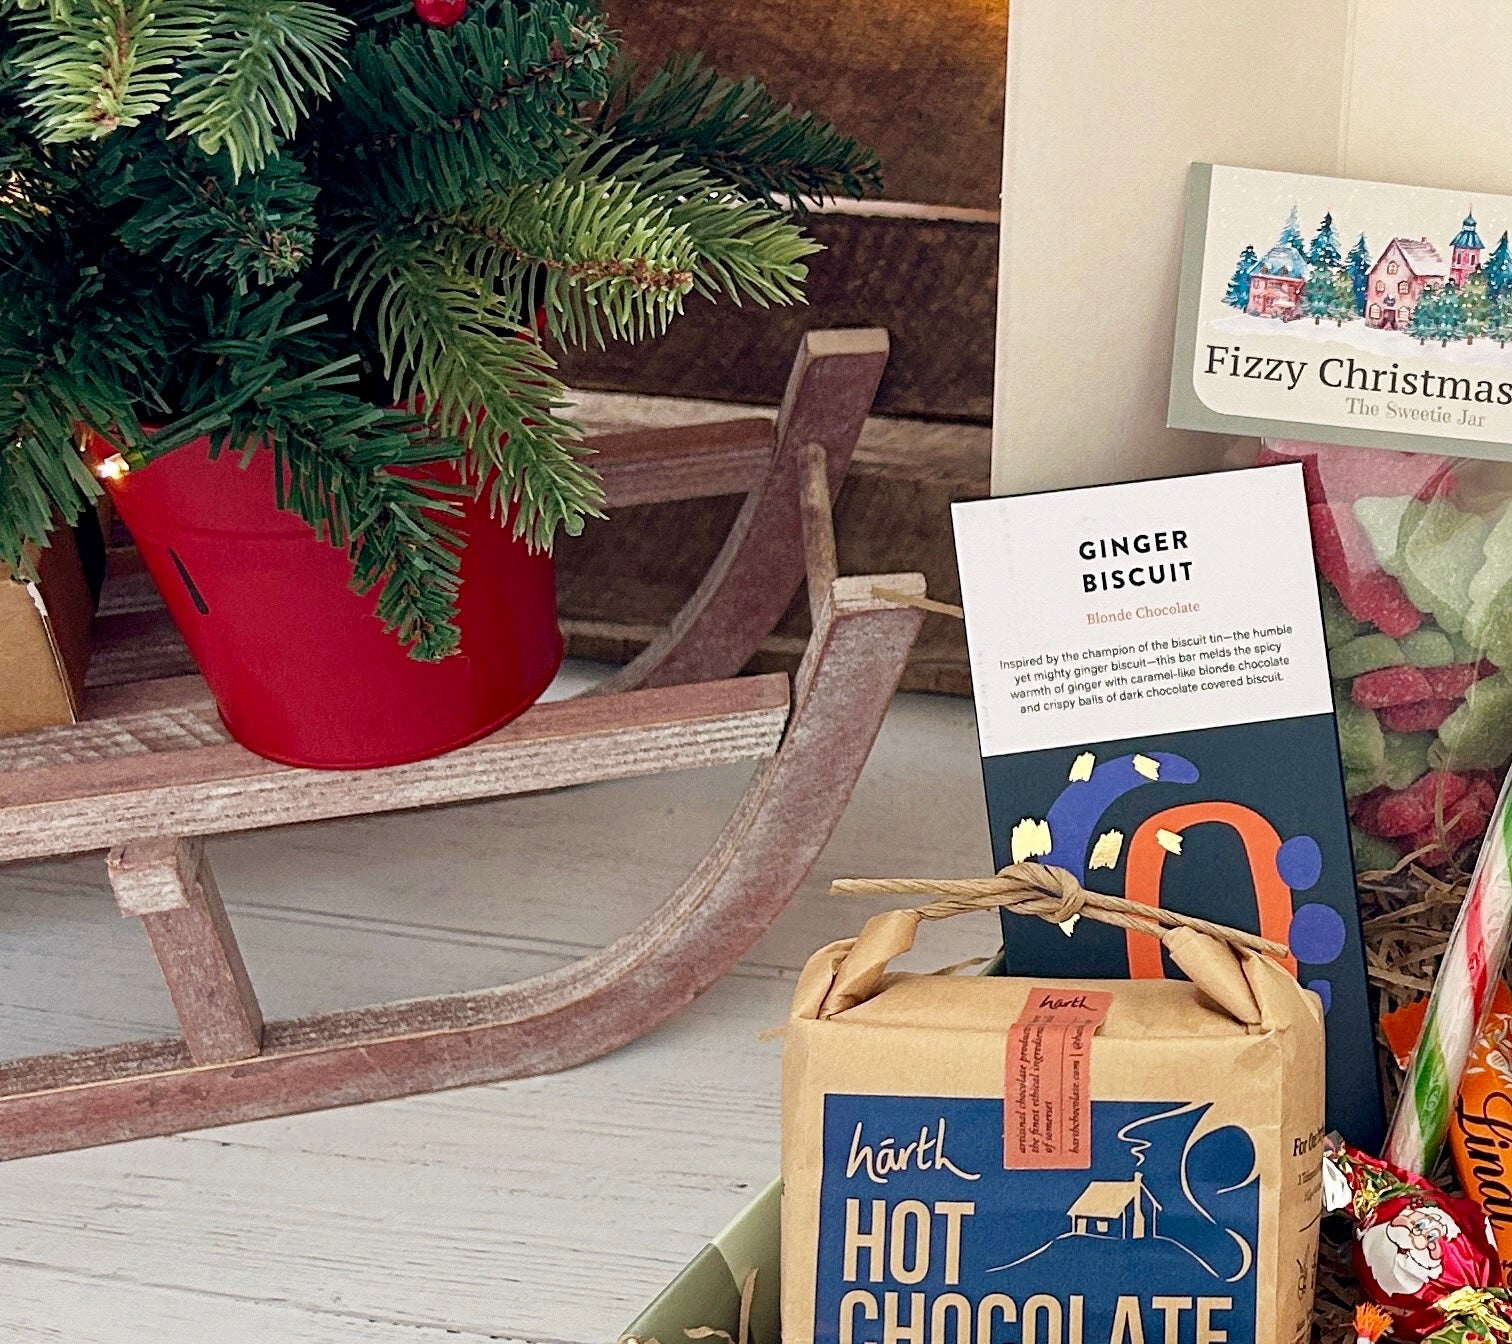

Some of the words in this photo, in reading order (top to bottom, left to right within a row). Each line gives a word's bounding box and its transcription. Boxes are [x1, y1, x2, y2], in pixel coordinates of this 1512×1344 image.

[1203, 344, 1309, 390] Fizzy
[1345, 396, 1381, 417] The
[1385, 398, 1452, 424] Sweetie
[1456, 408, 1486, 428] Jar
[1078, 529, 1189, 560] GINGER
[1082, 561, 1194, 593] BISCUIT
[1086, 608, 1133, 626] Blonde
[1135, 601, 1201, 621] Chocolate
[999, 655, 1043, 671] Inspired
[1046, 654, 1059, 665] by
[1061, 651, 1080, 662] the
[1082, 645, 1136, 660] champion
[1138, 641, 1149, 653] of
[1151, 640, 1169, 651] the
[1171, 634, 1207, 648] biscuit
[1252, 624, 1293, 638] humble
[1014, 673, 1031, 686] yet
[1034, 667, 1071, 681] mighty
[1074, 663, 1108, 678] ginger
[1178, 652, 1196, 663] bar
[1199, 647, 1231, 660] melds
[1233, 645, 1251, 656] the
[1254, 642, 1282, 654] spicy
[1010, 685, 1051, 699] warmth
[1054, 682, 1064, 693] of
[1067, 679, 1101, 694] ginger
[1105, 675, 1128, 688] with
[1199, 661, 1236, 676] blonde
[1238, 656, 1290, 671] chocolate
[1020, 702, 1040, 714] and
[1043, 698, 1076, 711] crispy
[1078, 694, 1104, 706] balls
[1106, 691, 1117, 703] of
[1119, 689, 1143, 701] dark
[1146, 682, 1198, 698] chocolate
[1201, 676, 1244, 691] covered
[1015, 1065, 1027, 1109] chocolate
[1029, 1072, 1040, 1107] ethical
[1029, 1109, 1043, 1137] finest
[1028, 1137, 1040, 1153] the
[1042, 1141, 1056, 1153] of
[842, 1197, 976, 1286] HOT
